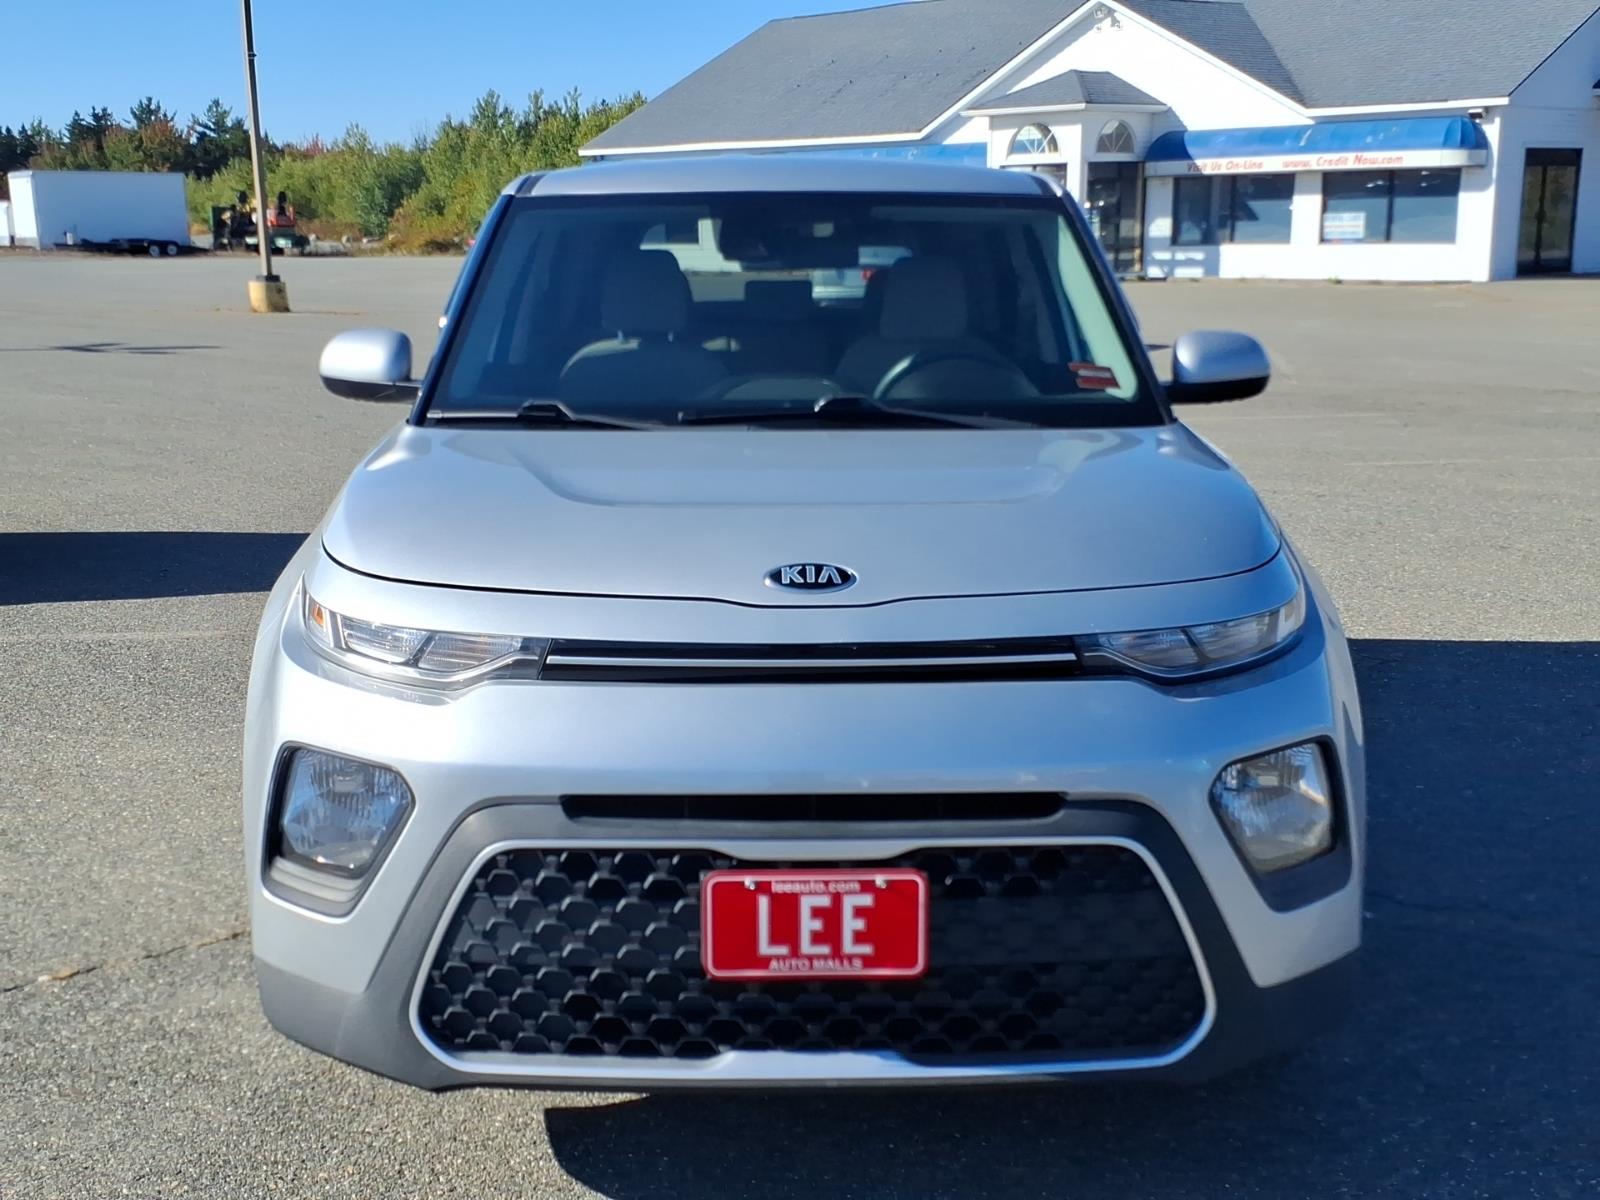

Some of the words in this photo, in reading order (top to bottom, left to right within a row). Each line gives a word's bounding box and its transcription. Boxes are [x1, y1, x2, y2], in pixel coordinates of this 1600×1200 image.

[1210, 161, 1222, 171] Us
[1316, 156, 1349, 167] Credit
[1353, 154, 1404, 166] Now.com
[781, 565, 842, 584] KIA
[771, 880, 861, 894] leeauto.com
[757, 894, 875, 956] LEE
[769, 957, 811, 971] AUTO
[812, 957, 864, 971] MALLS
